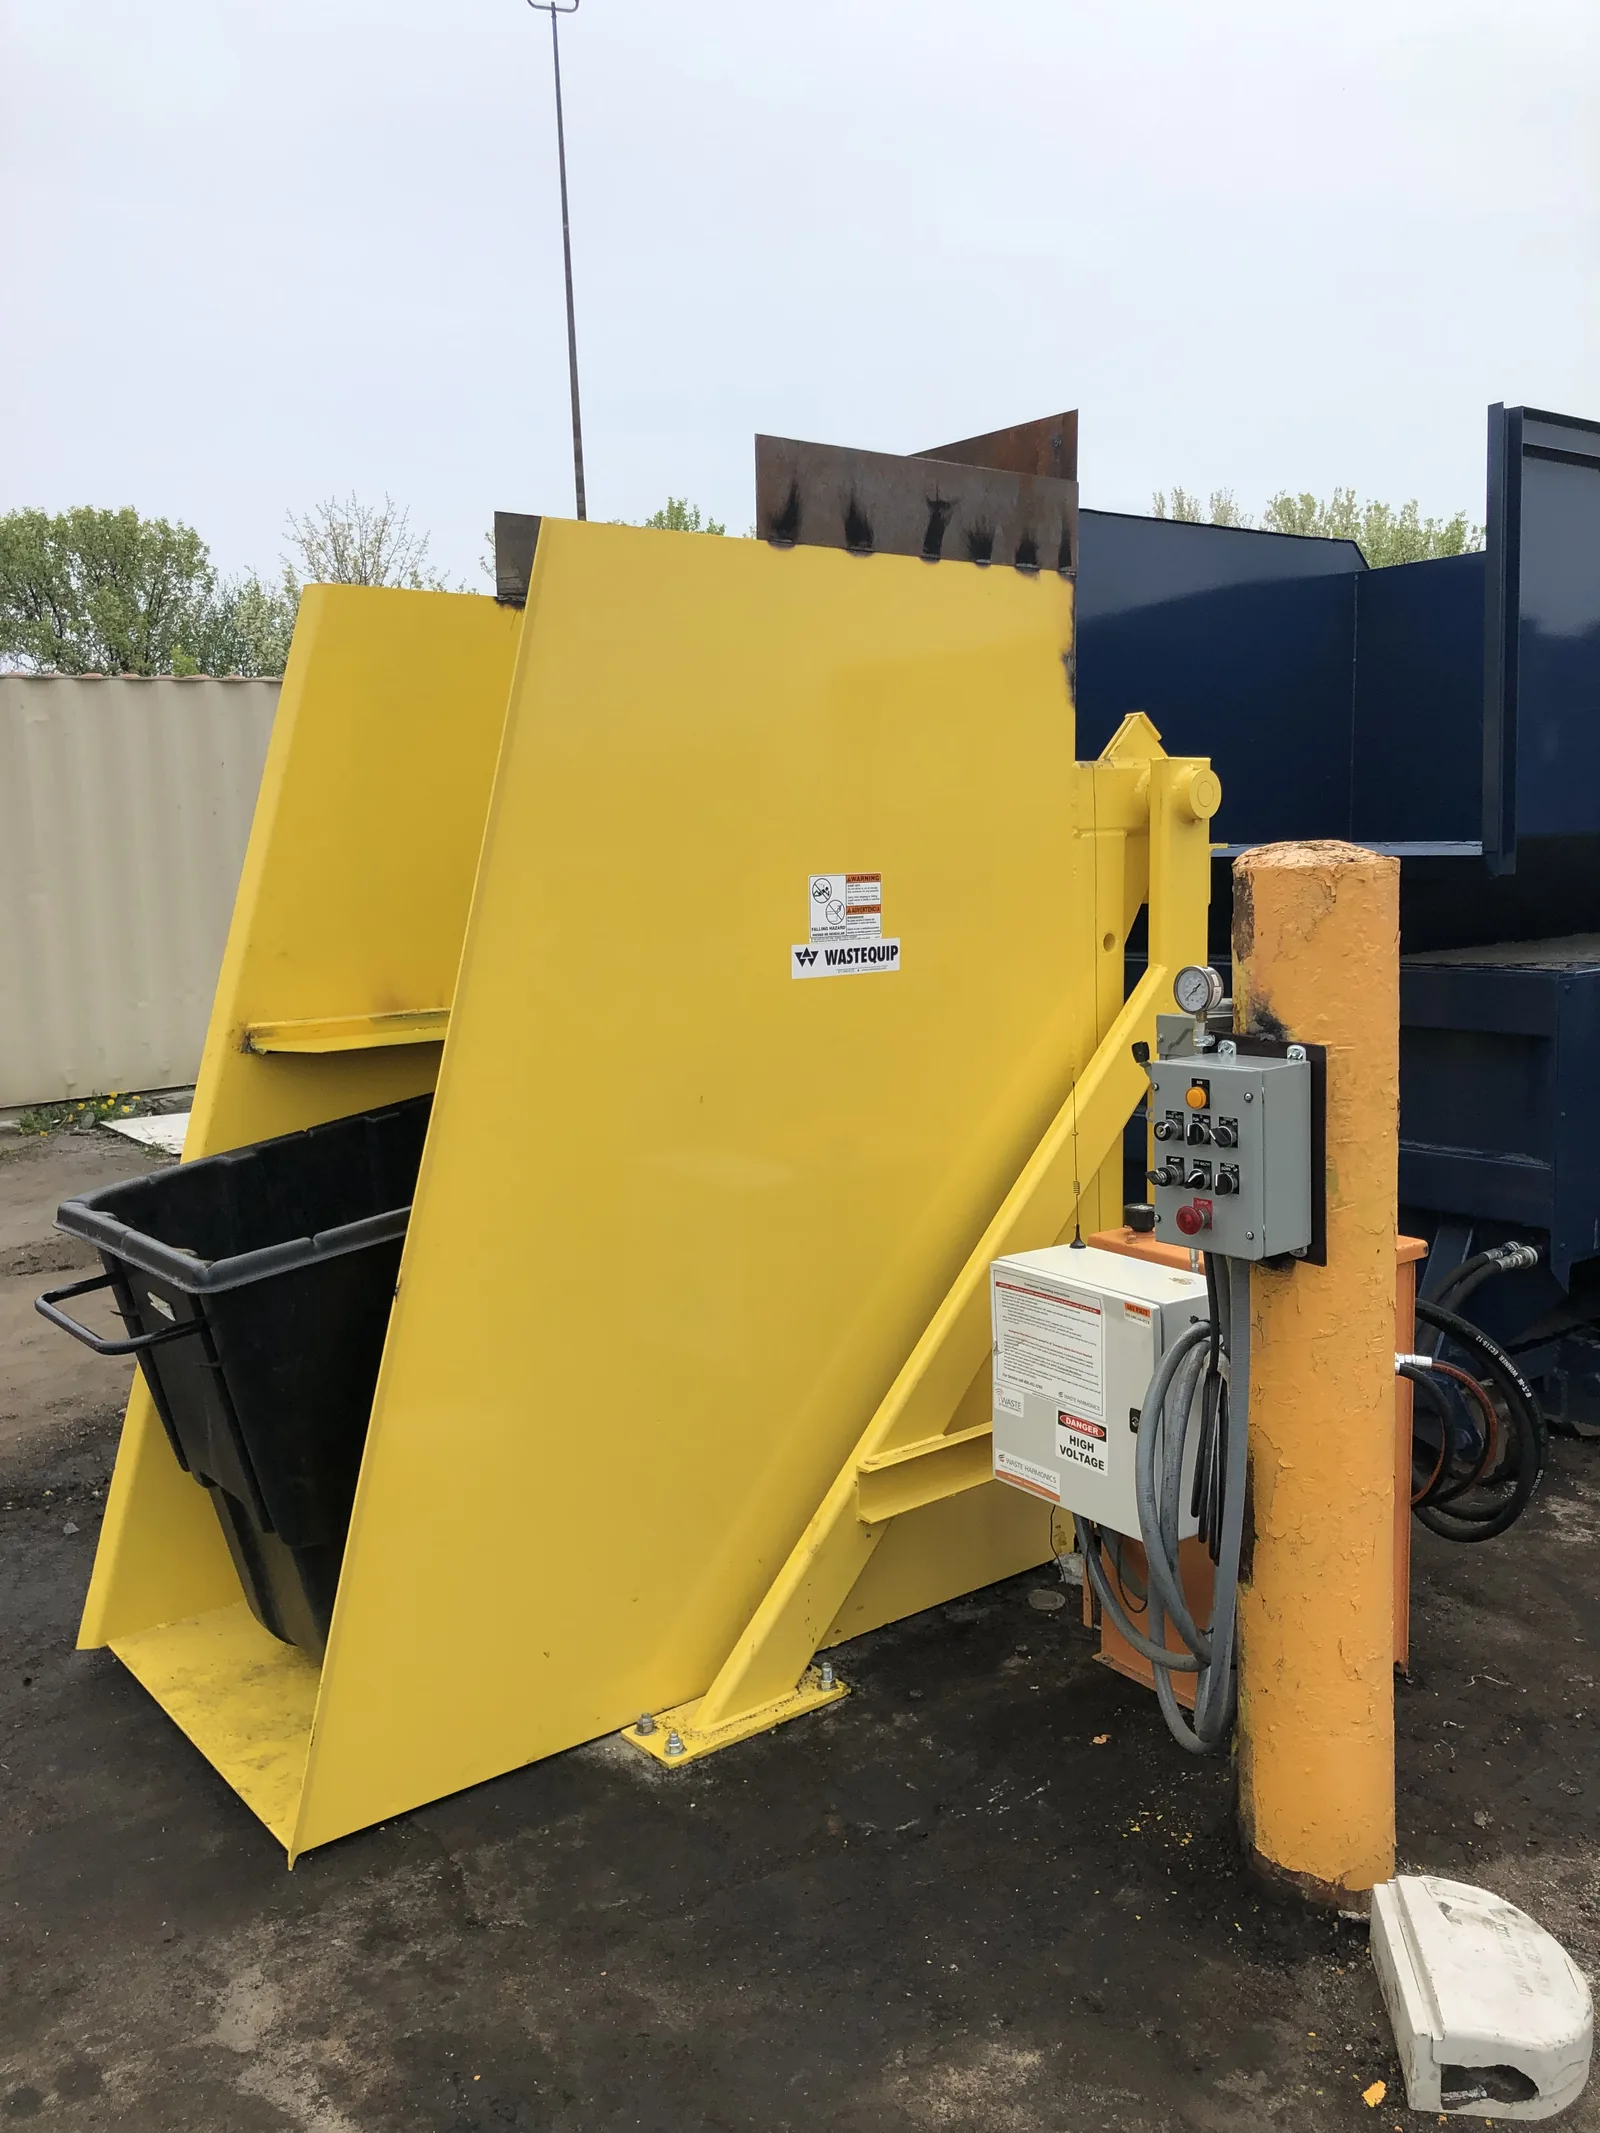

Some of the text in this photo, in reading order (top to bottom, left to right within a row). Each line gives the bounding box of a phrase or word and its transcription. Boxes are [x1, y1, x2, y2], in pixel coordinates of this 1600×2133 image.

[825, 945, 899, 966] WASTEQUIP
[1499, 1355, 1518, 1377] WINNER
[1065, 1417, 1099, 1436] DANGER
[1069, 1435, 1095, 1453] HIGH
[1060, 1445, 1105, 1471] VOLTAGE
[1006, 1458, 1023, 1470] WASTE
[1024, 1465, 1057, 1484] HARMONICS
